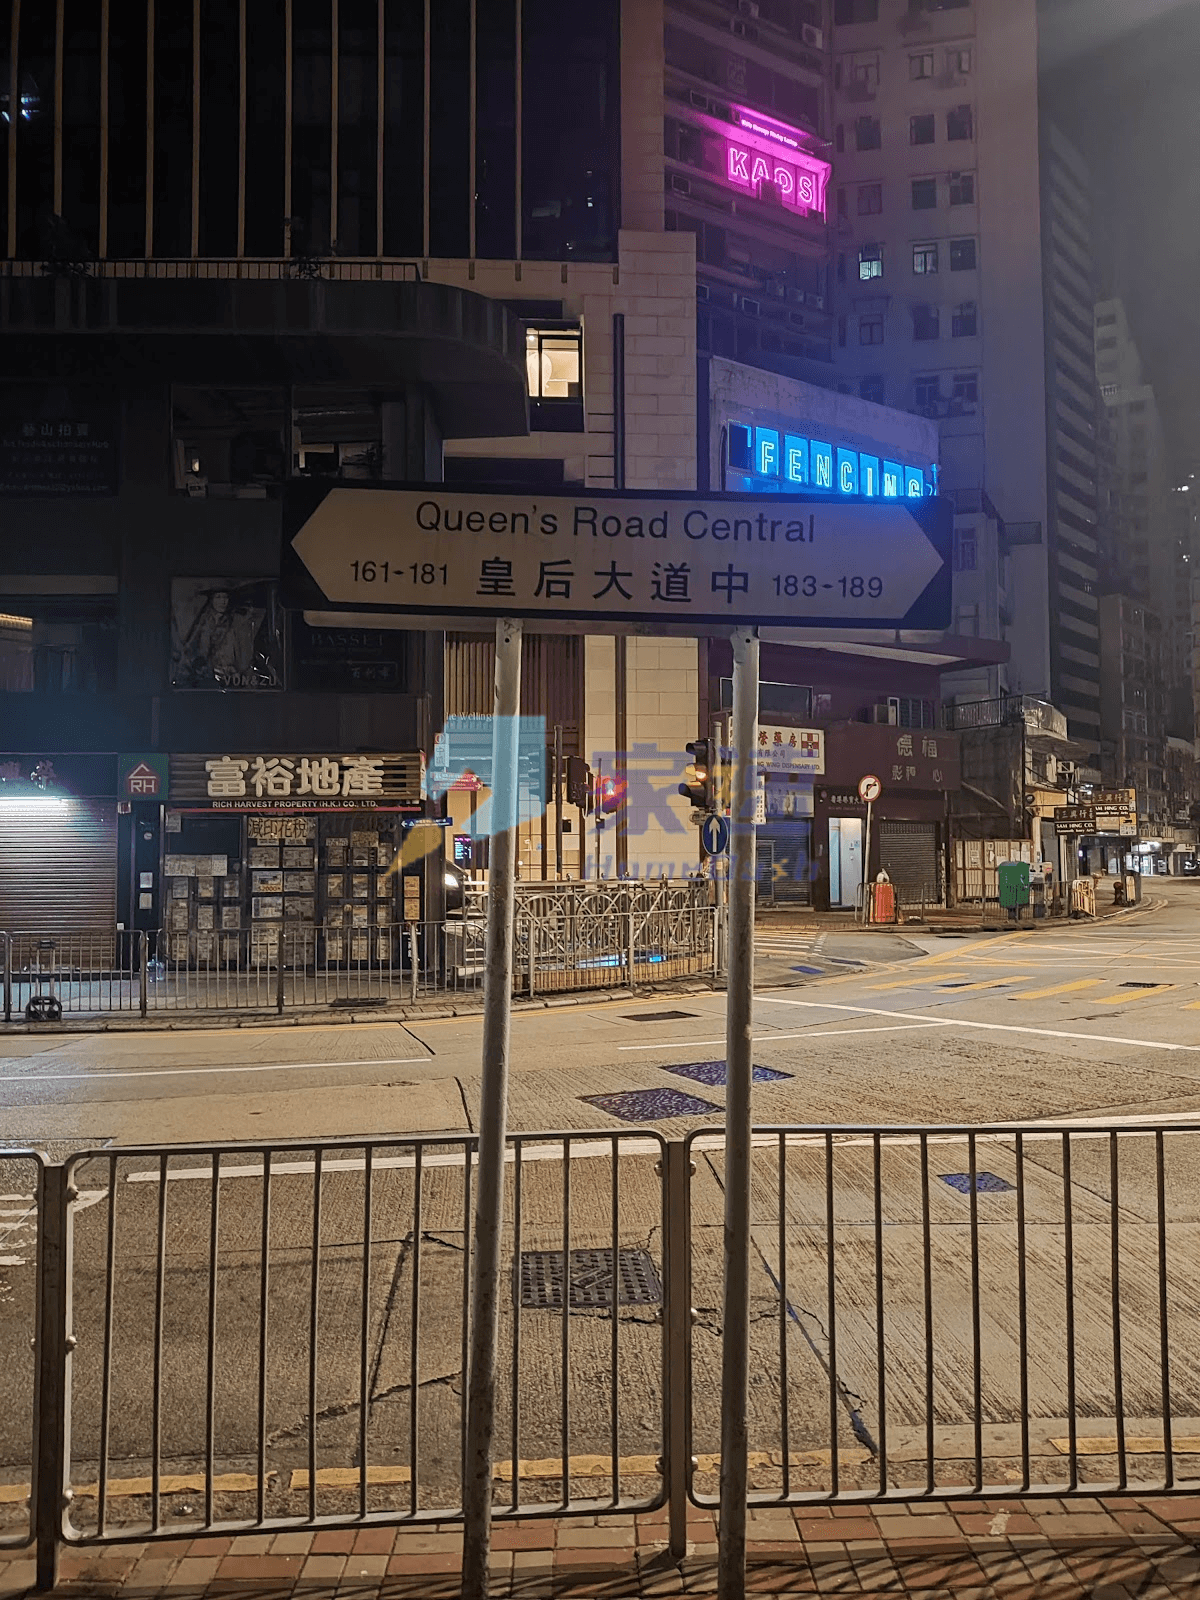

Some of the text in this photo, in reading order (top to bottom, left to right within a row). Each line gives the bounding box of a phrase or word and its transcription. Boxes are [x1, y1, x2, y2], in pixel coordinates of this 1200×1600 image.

[729, 147, 813, 203] KAOS
[760, 440, 921, 497] FENCING
[416, 501, 815, 543] Queen's Road Central
[350, 560, 449, 586] 161-181
[476, 556, 749, 604] 皇后大道中
[771, 574, 884, 599] 183-189
[130, 779, 155, 793] RH
[205, 755, 385, 798] 富裕地產
[212, 800, 232, 809] RICH
[234, 800, 272, 809] HARVEST
[274, 800, 318, 809] PROPERTY
[319, 800, 341, 809] (H.K.)
[361, 800, 379, 810] LTD.
[248, 817, 307, 838] 減印花稅
